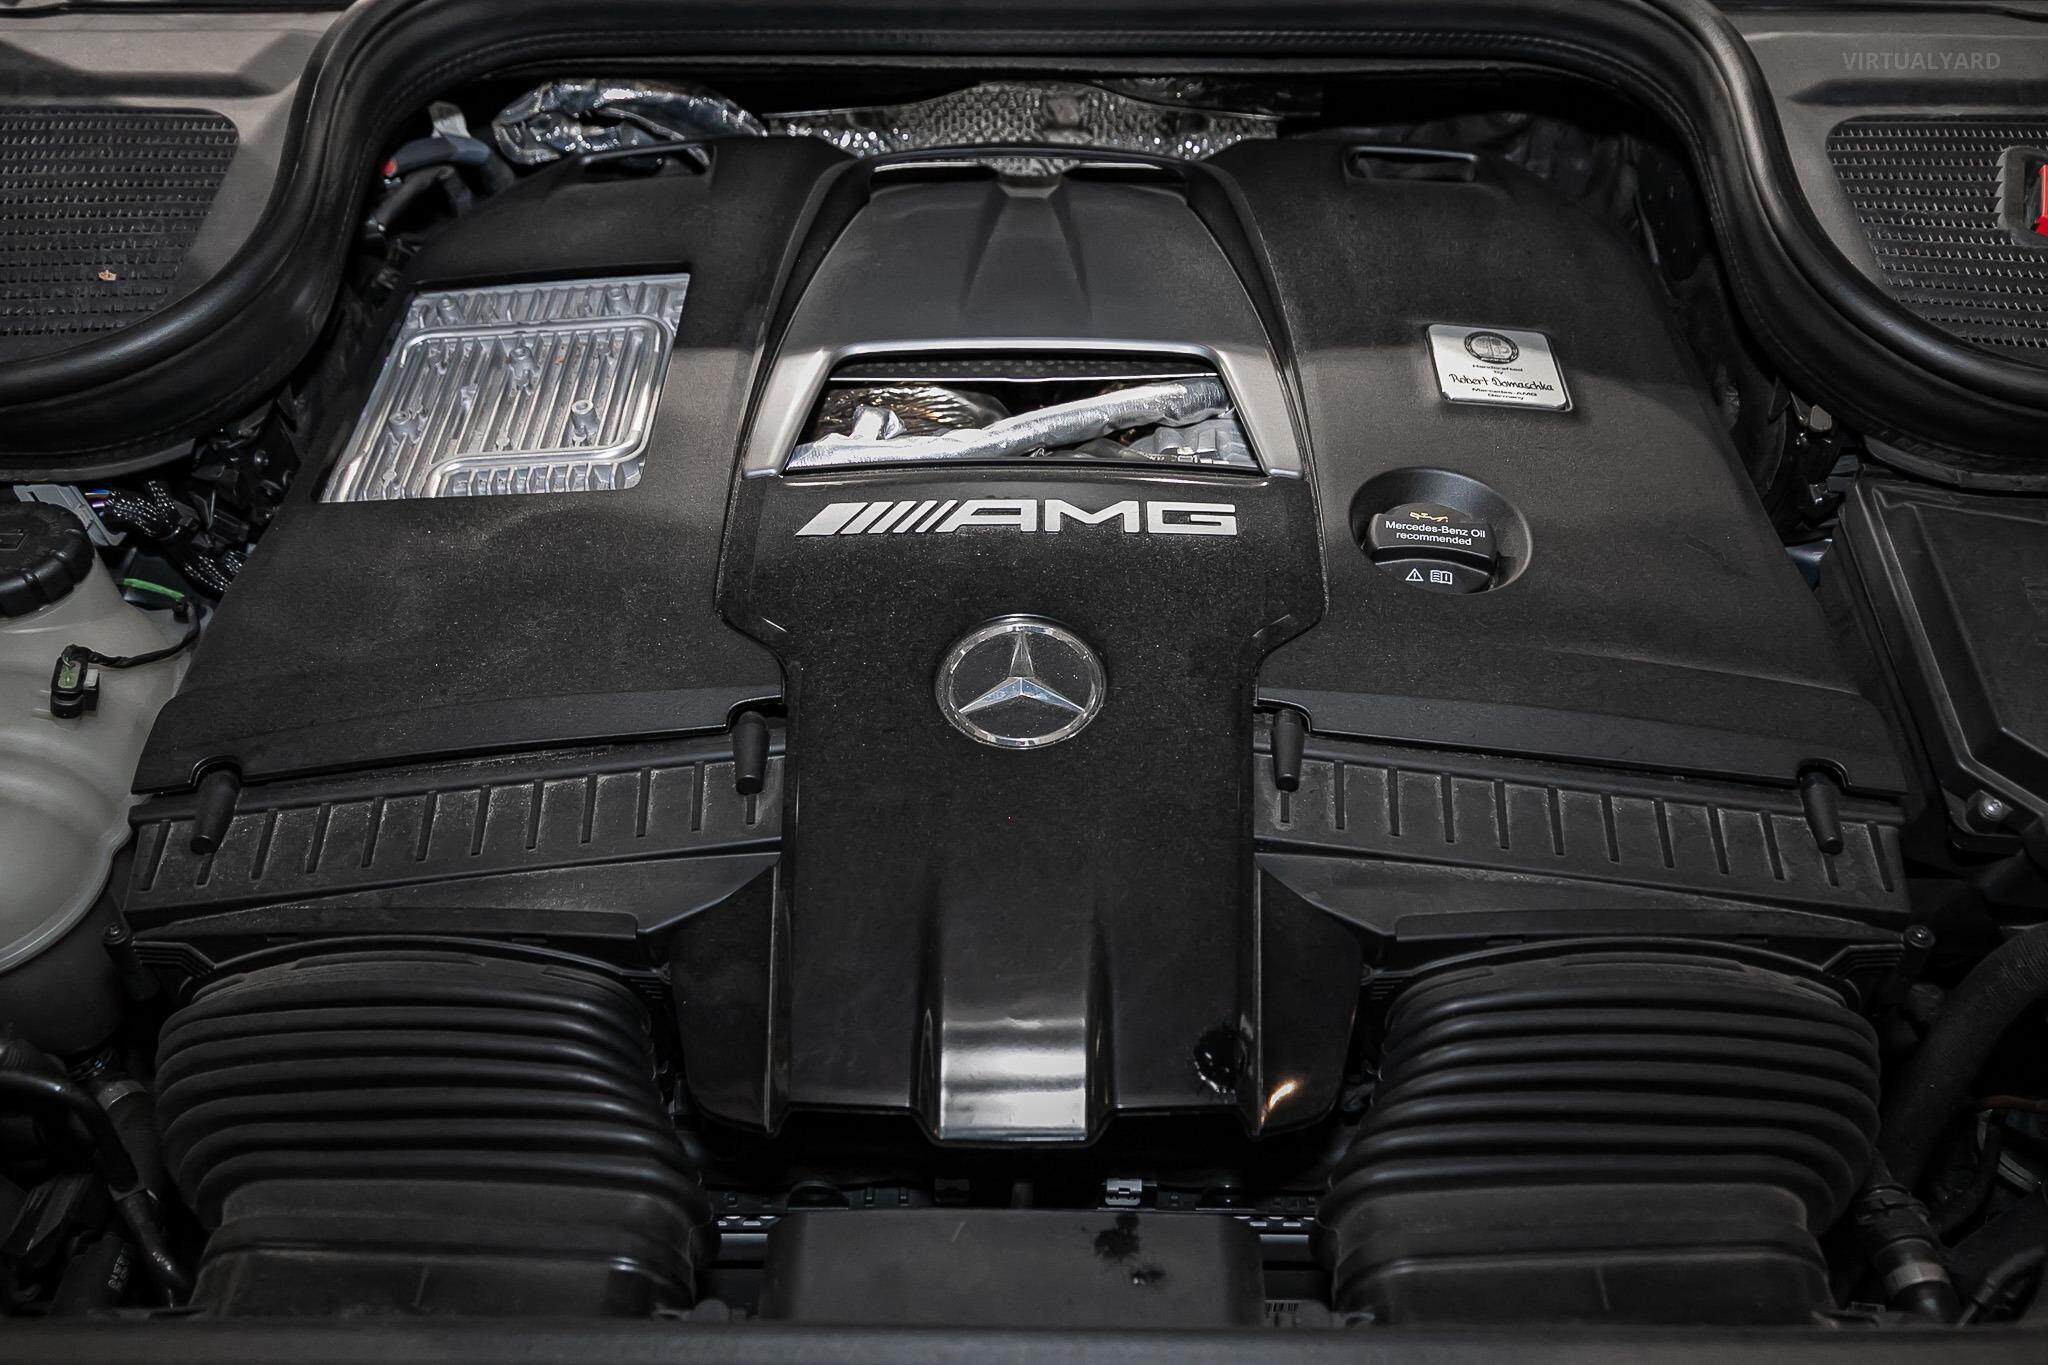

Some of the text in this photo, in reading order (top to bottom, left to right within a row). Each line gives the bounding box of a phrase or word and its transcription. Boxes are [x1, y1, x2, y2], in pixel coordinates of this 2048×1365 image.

[1448, 373, 1554, 391] Robert Domaschka
[935, 499, 1238, 536] AMG
[1385, 520, 1486, 538] Mercedes-Benz Oil
[1396, 532, 1472, 546] recommended
